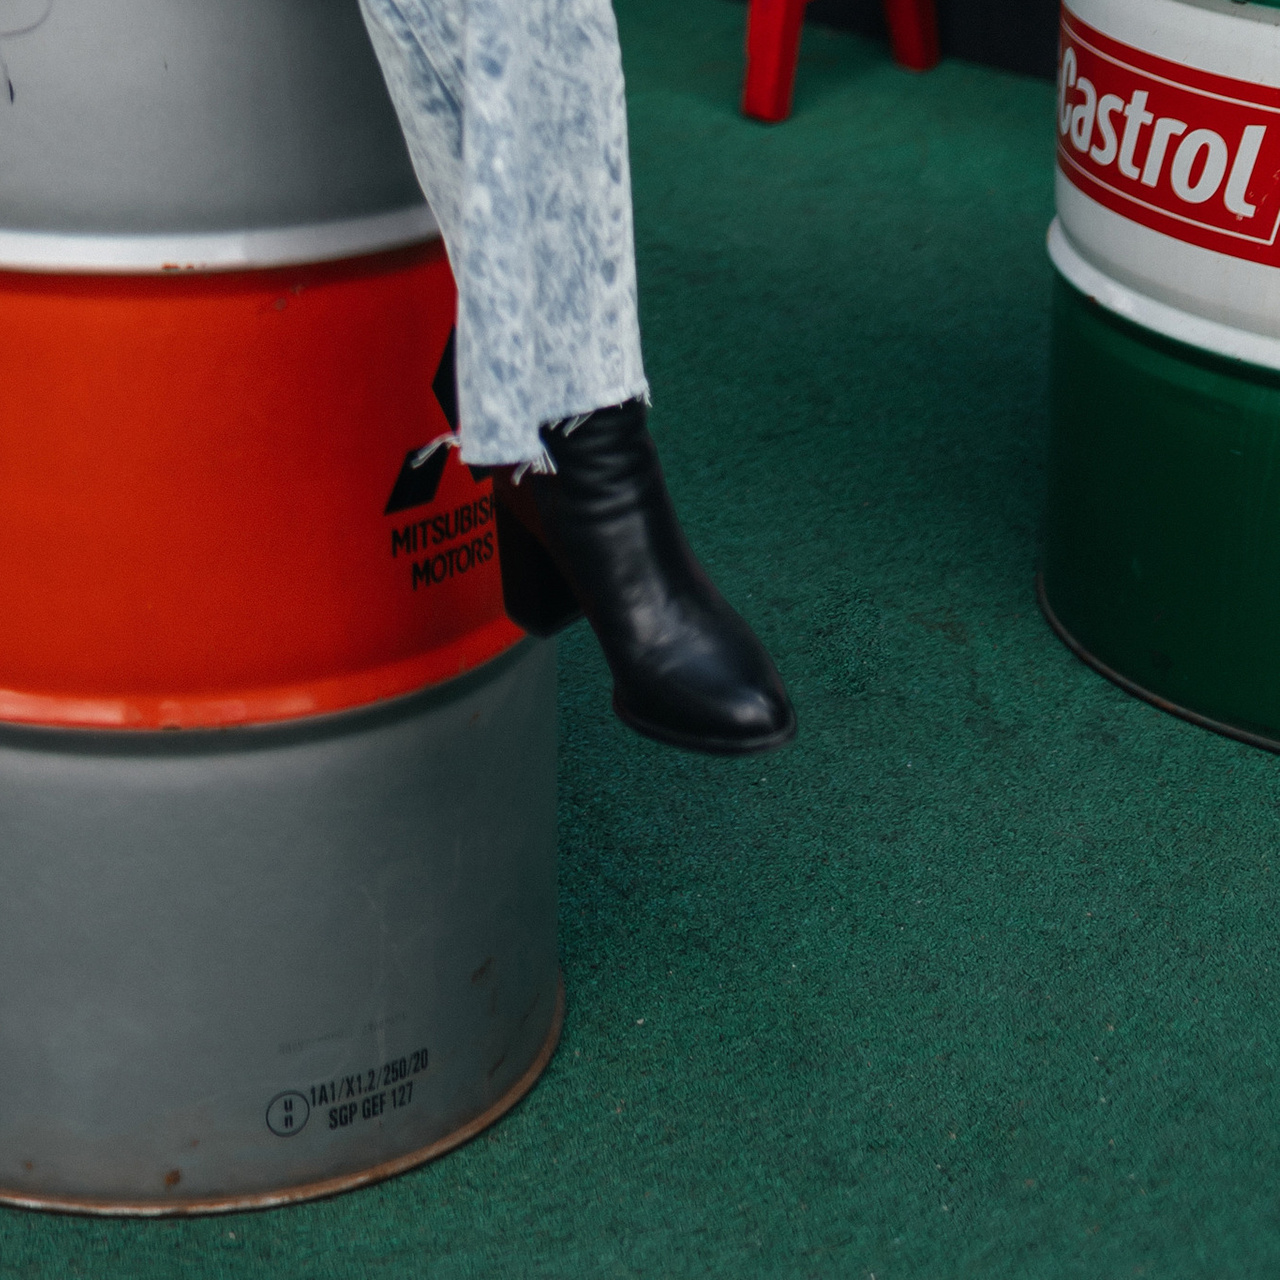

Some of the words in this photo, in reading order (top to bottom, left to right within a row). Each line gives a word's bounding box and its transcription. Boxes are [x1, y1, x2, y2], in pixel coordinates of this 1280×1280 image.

[1058, 46, 1267, 219] Castrol
[412, 532, 494, 591] MOTORS
[310, 1048, 429, 1108] 1A1/X1.2/250/20
[328, 1101, 358, 1130] SGP
[362, 1092, 387, 1120] GEF
[391, 1081, 414, 1109] 127
